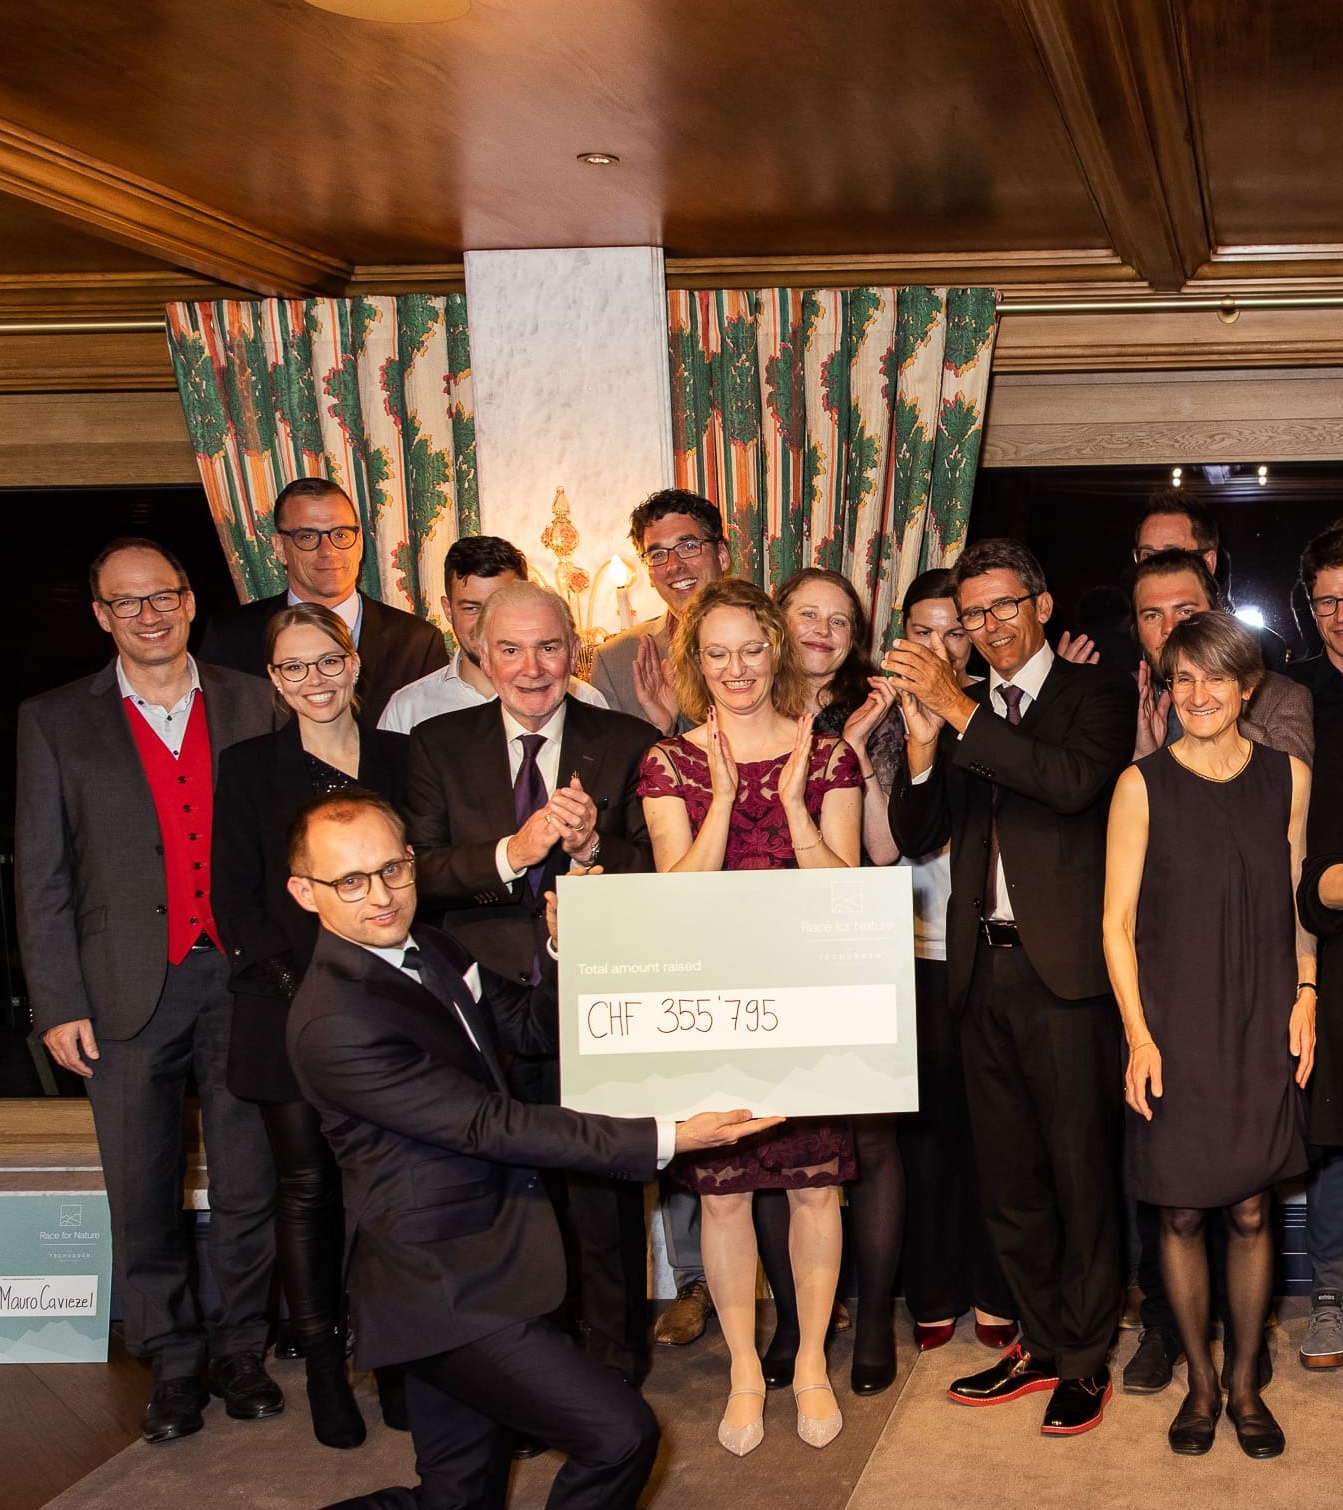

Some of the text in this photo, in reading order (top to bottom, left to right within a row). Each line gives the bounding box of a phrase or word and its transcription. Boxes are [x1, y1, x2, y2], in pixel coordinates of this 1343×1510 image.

[800, 919, 895, 934] Race for Nature
[578, 959, 702, 975] Total amount raised
[587, 995, 779, 1039] CHF 355'795
[40, 1231, 100, 1240] Race for Nature
[0, 1284, 94, 1310] Mauro Caviezel
